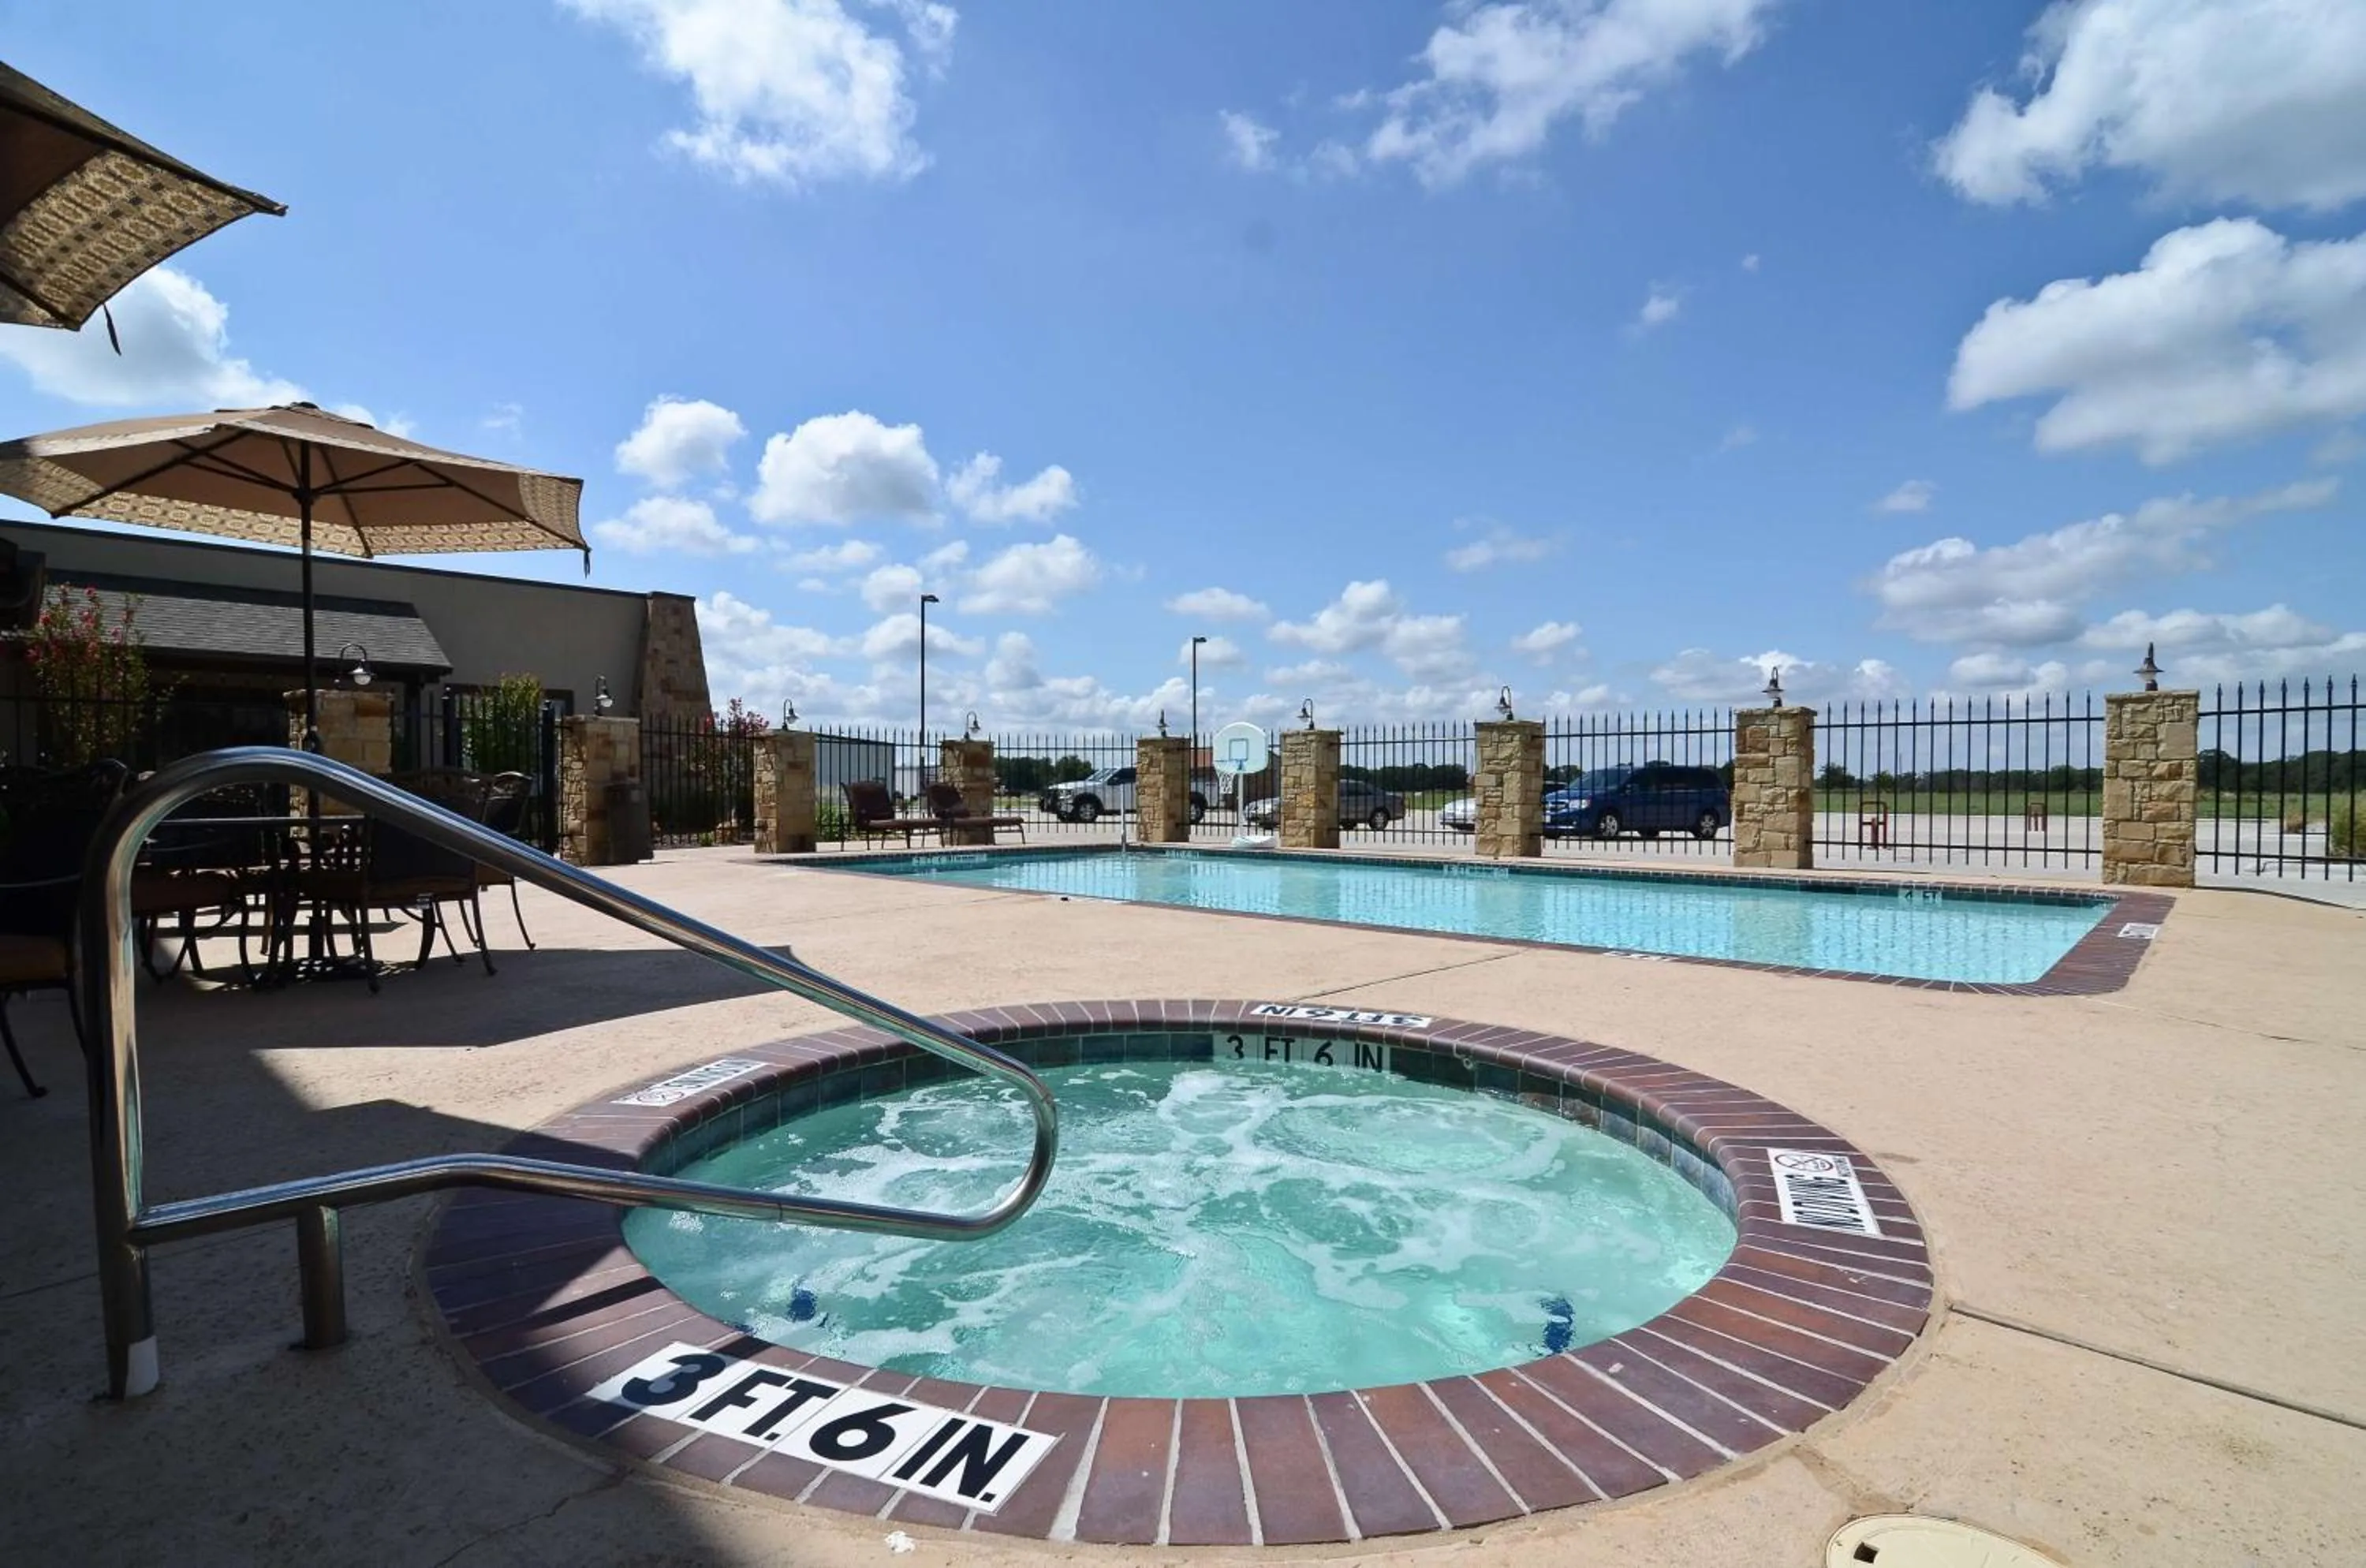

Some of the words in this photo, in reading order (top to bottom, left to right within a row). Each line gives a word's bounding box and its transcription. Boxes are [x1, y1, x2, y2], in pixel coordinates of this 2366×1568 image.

[1262, 1006, 1297, 1016] IN
[1306, 1007, 1335, 1017] 6
[1347, 1012, 1383, 1023] FT
[1391, 1016, 1424, 1025] 3
[1226, 1035, 1245, 1061] 3
[1265, 1036, 1296, 1062] FT
[1313, 1040, 1334, 1066] 6
[1354, 1043, 1383, 1073] IN
[621, 1353, 726, 1406] 3
[689, 1369, 840, 1442] FT.
[809, 1403, 917, 1461] 6
[893, 1417, 1030, 1503] IN.
